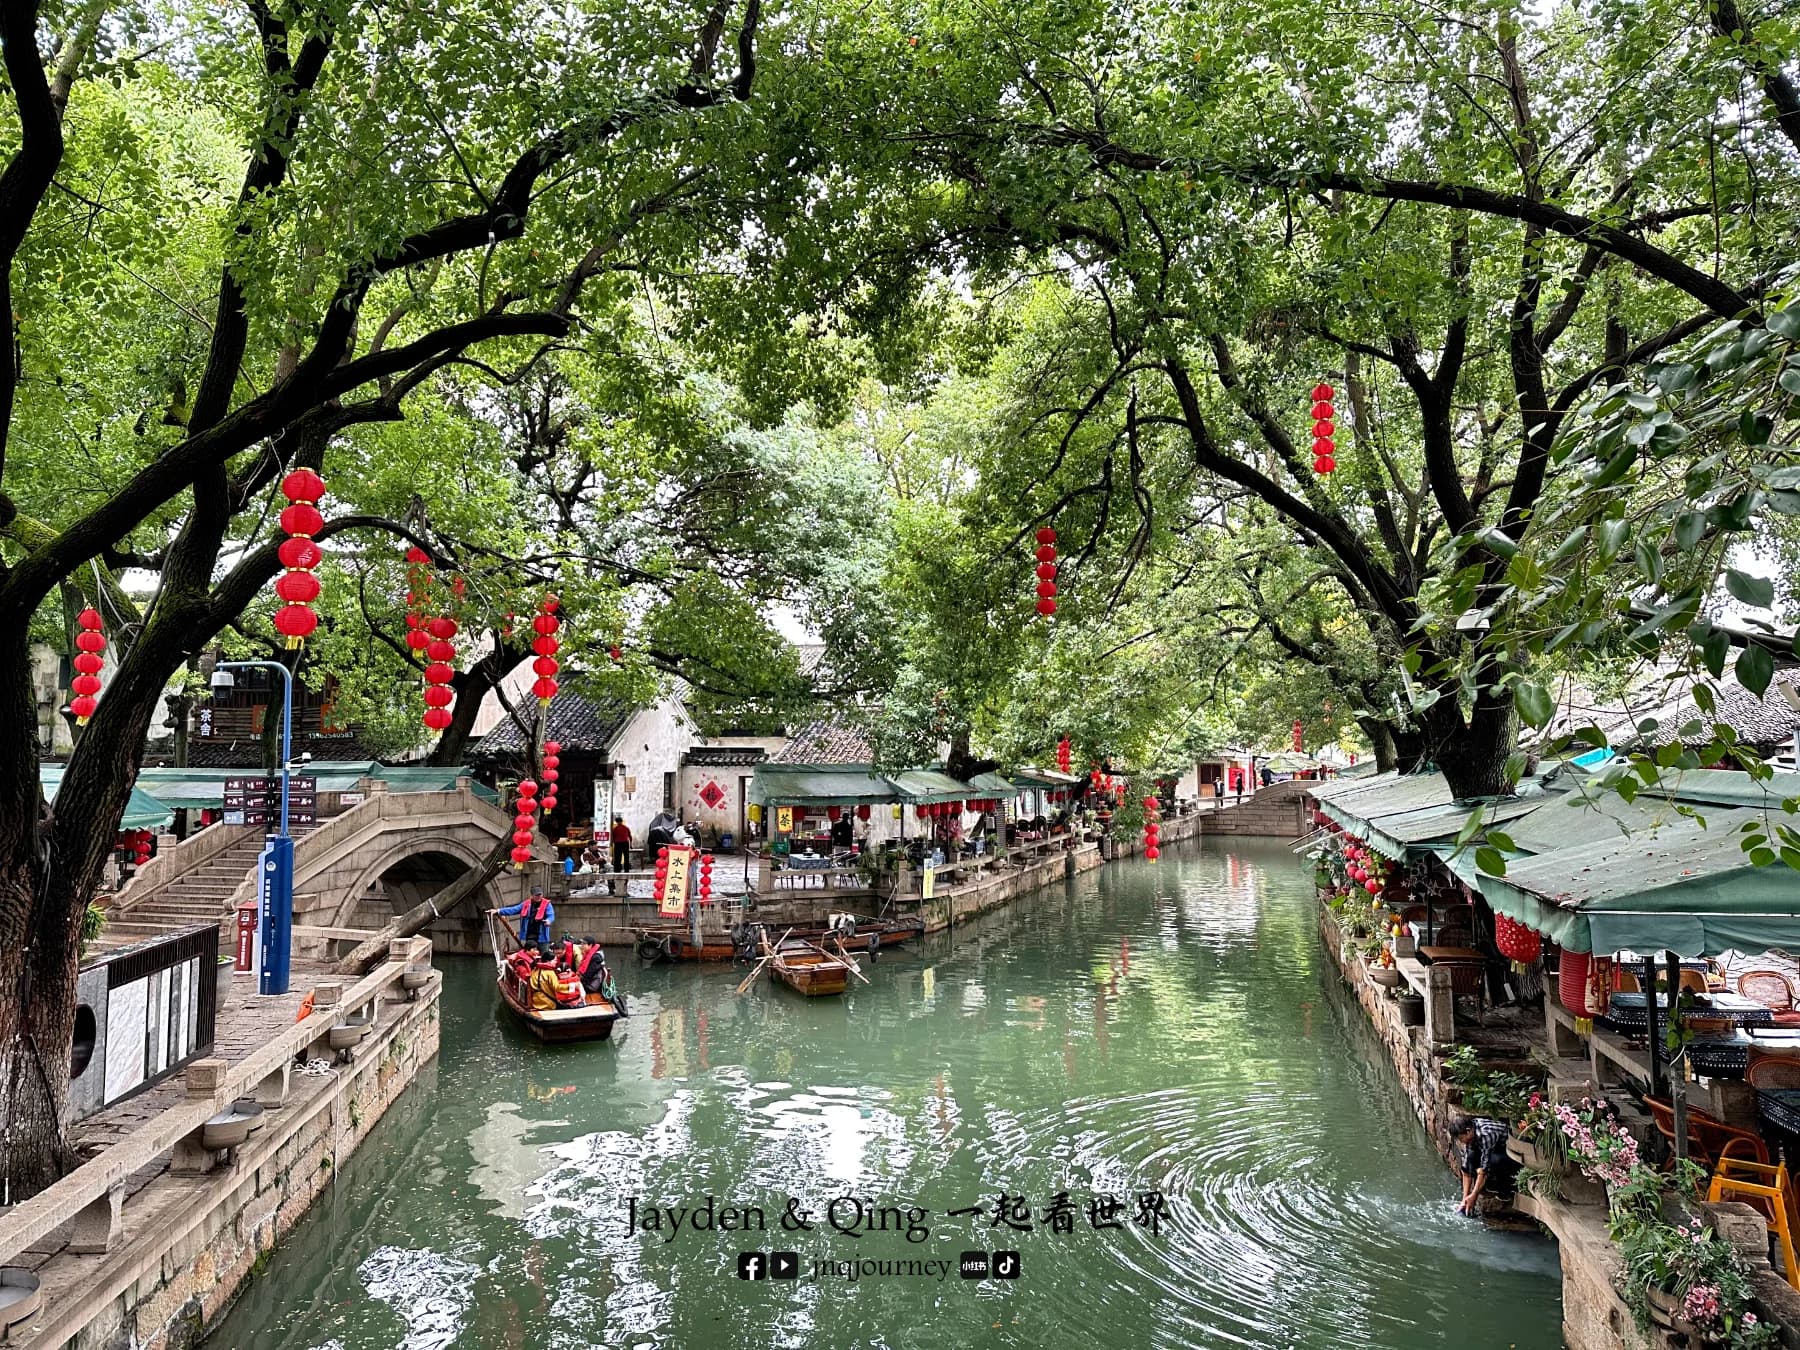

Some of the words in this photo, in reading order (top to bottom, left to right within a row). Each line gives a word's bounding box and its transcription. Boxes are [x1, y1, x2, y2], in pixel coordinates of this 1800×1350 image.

[200, 709, 212, 736] 茶舍
[779, 813, 791, 827] 茶
[667, 856, 684, 906] 水上集市
